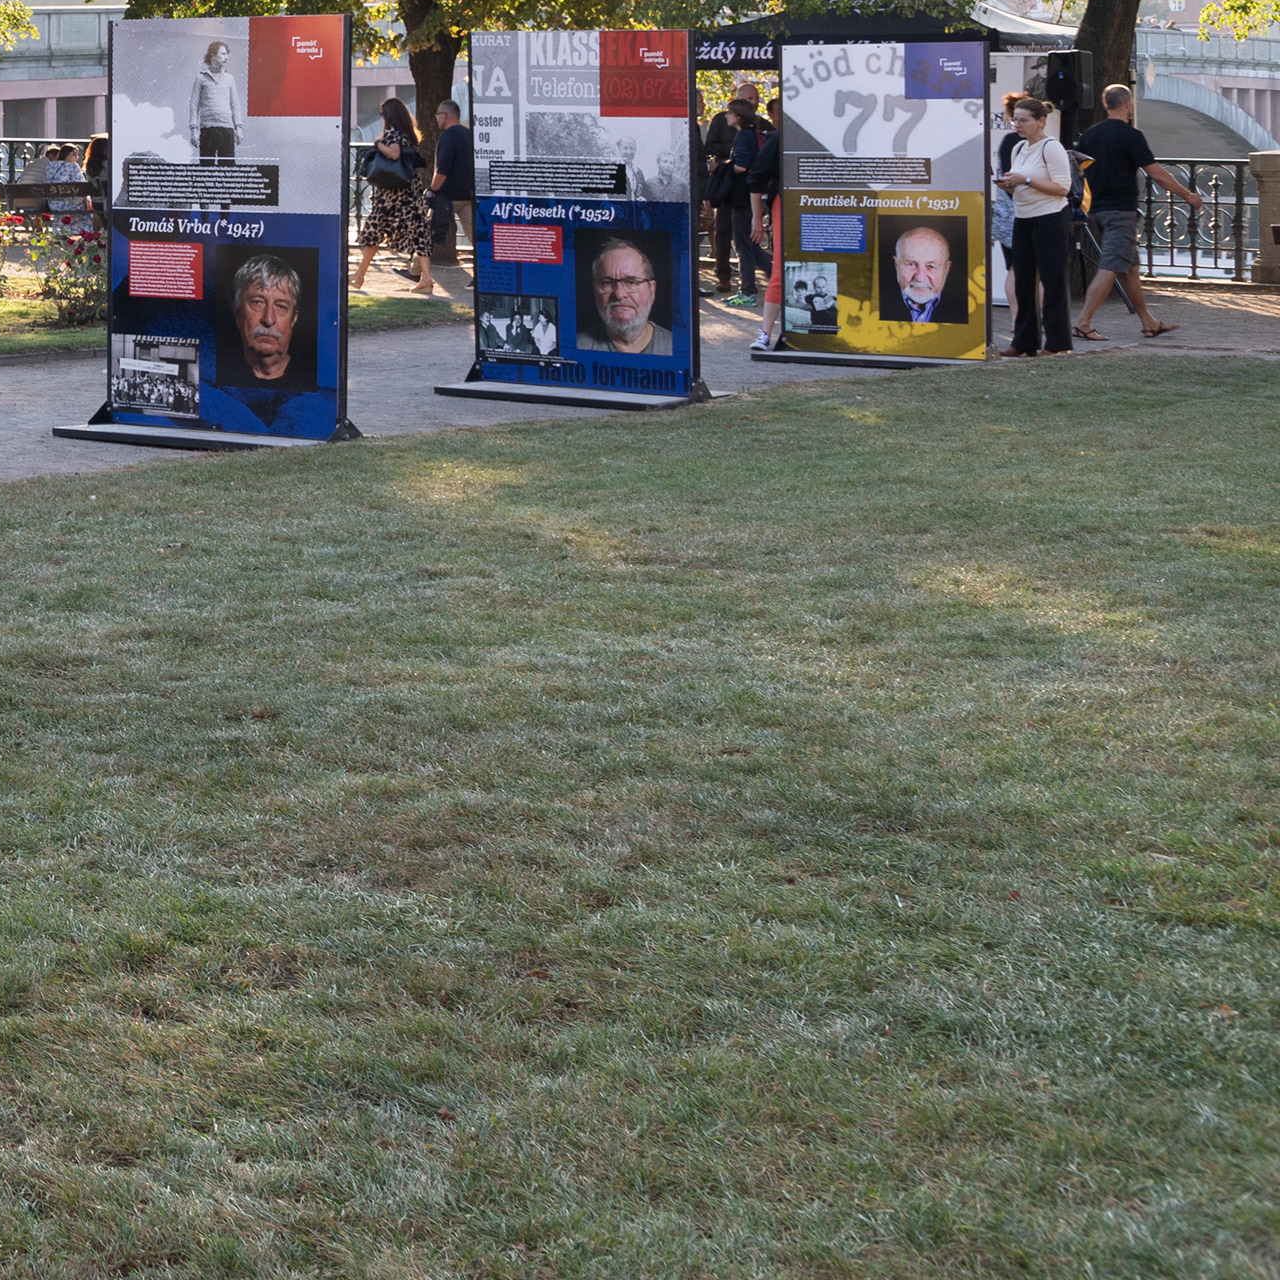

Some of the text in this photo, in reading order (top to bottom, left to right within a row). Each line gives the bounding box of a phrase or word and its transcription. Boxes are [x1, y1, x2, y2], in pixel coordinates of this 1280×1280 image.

[740, 41, 774, 60] má
[531, 77, 600, 98] Telefon:
[604, 77, 639, 102] (02)
[642, 78, 666, 99] 67
[834, 90, 928, 157] 77
[479, 132, 490, 144] og
[799, 194, 858, 207] František
[859, 196, 913, 208] Janouch
[490, 202, 512, 219] Alf
[512, 203, 566, 220] Skjeseth
[129, 217, 174, 233] Tomáš
[178, 218, 211, 234] Vrba
[592, 362, 676, 392] formann
